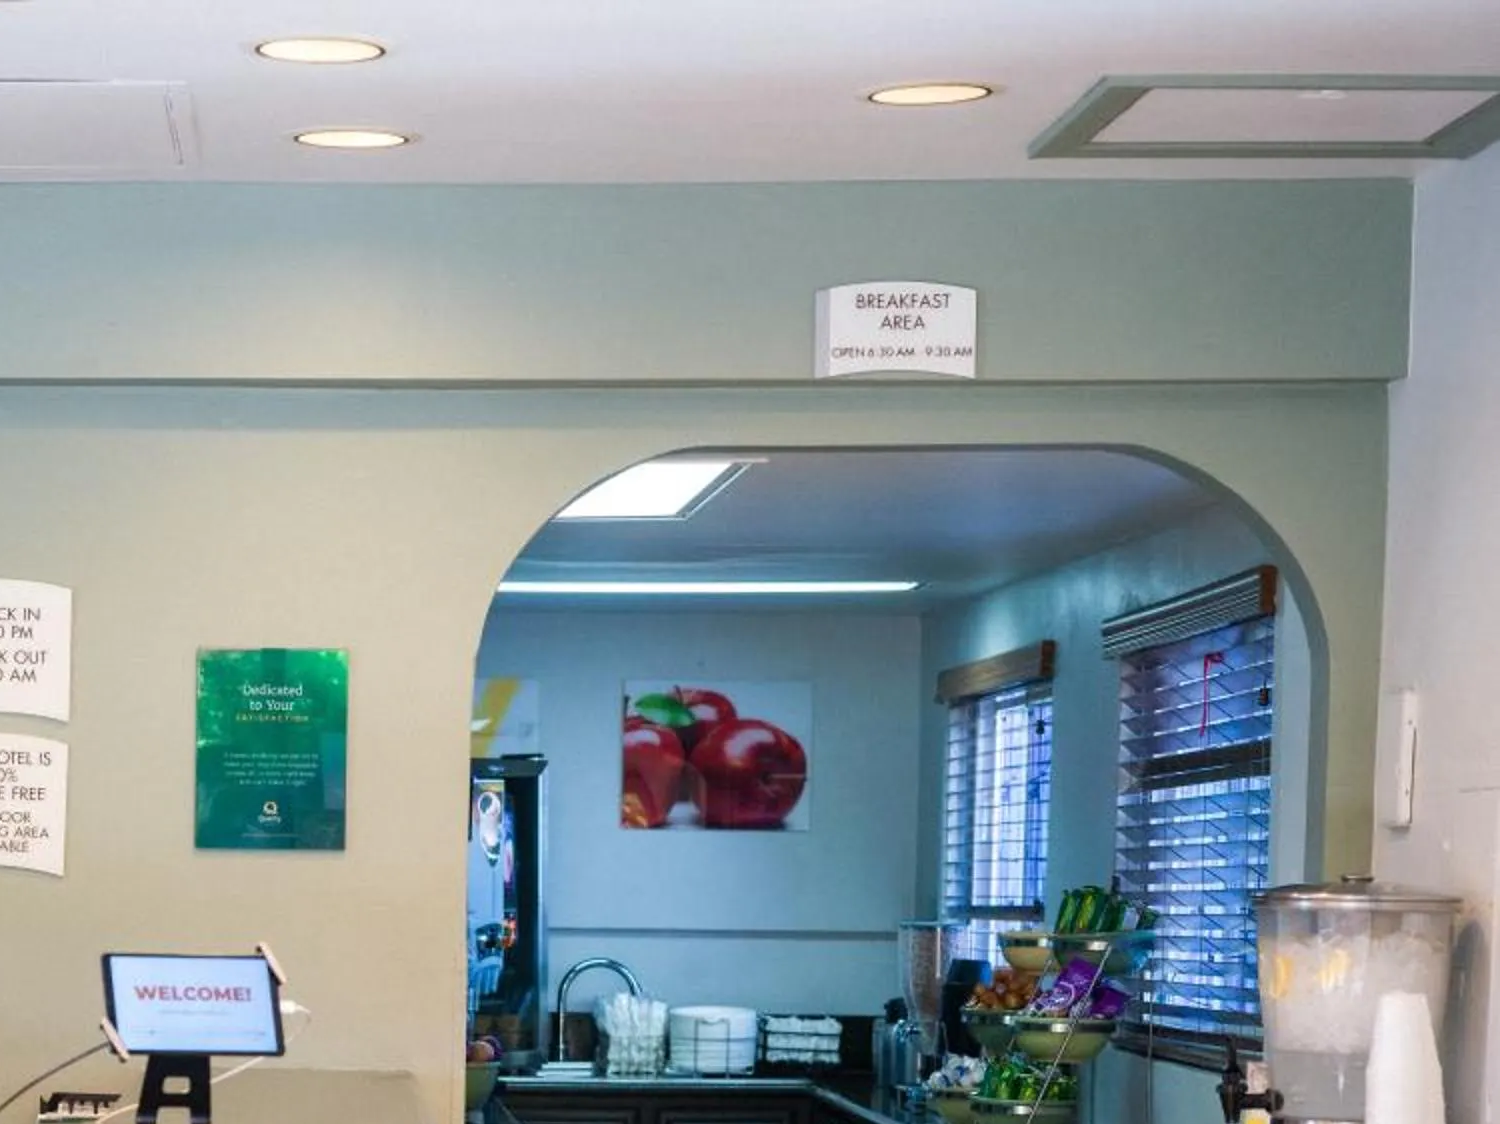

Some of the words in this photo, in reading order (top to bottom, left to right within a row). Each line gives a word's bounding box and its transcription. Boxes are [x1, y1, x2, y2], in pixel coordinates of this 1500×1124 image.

[855, 293, 951, 310] BREAKFAST
[880, 315, 926, 330] AREA
[831, 347, 866, 359] OPEN
[867, 347, 895, 358] 630
[895, 347, 916, 357] AM
[925, 346, 952, 358] 930
[953, 346, 973, 358] AM
[23, 607, 41, 621] IN
[11, 625, 34, 639] PM
[13, 650, 48, 666] OUT
[9, 668, 37, 683] AM
[243, 683, 303, 697] Dedicated
[250, 700, 263, 711] to
[266, 699, 296, 711] Your
[39, 751, 52, 766] IS
[11, 786, 46, 801] FREE
[13, 825, 50, 839] AREA
[134, 985, 252, 1002] WELCOME!
